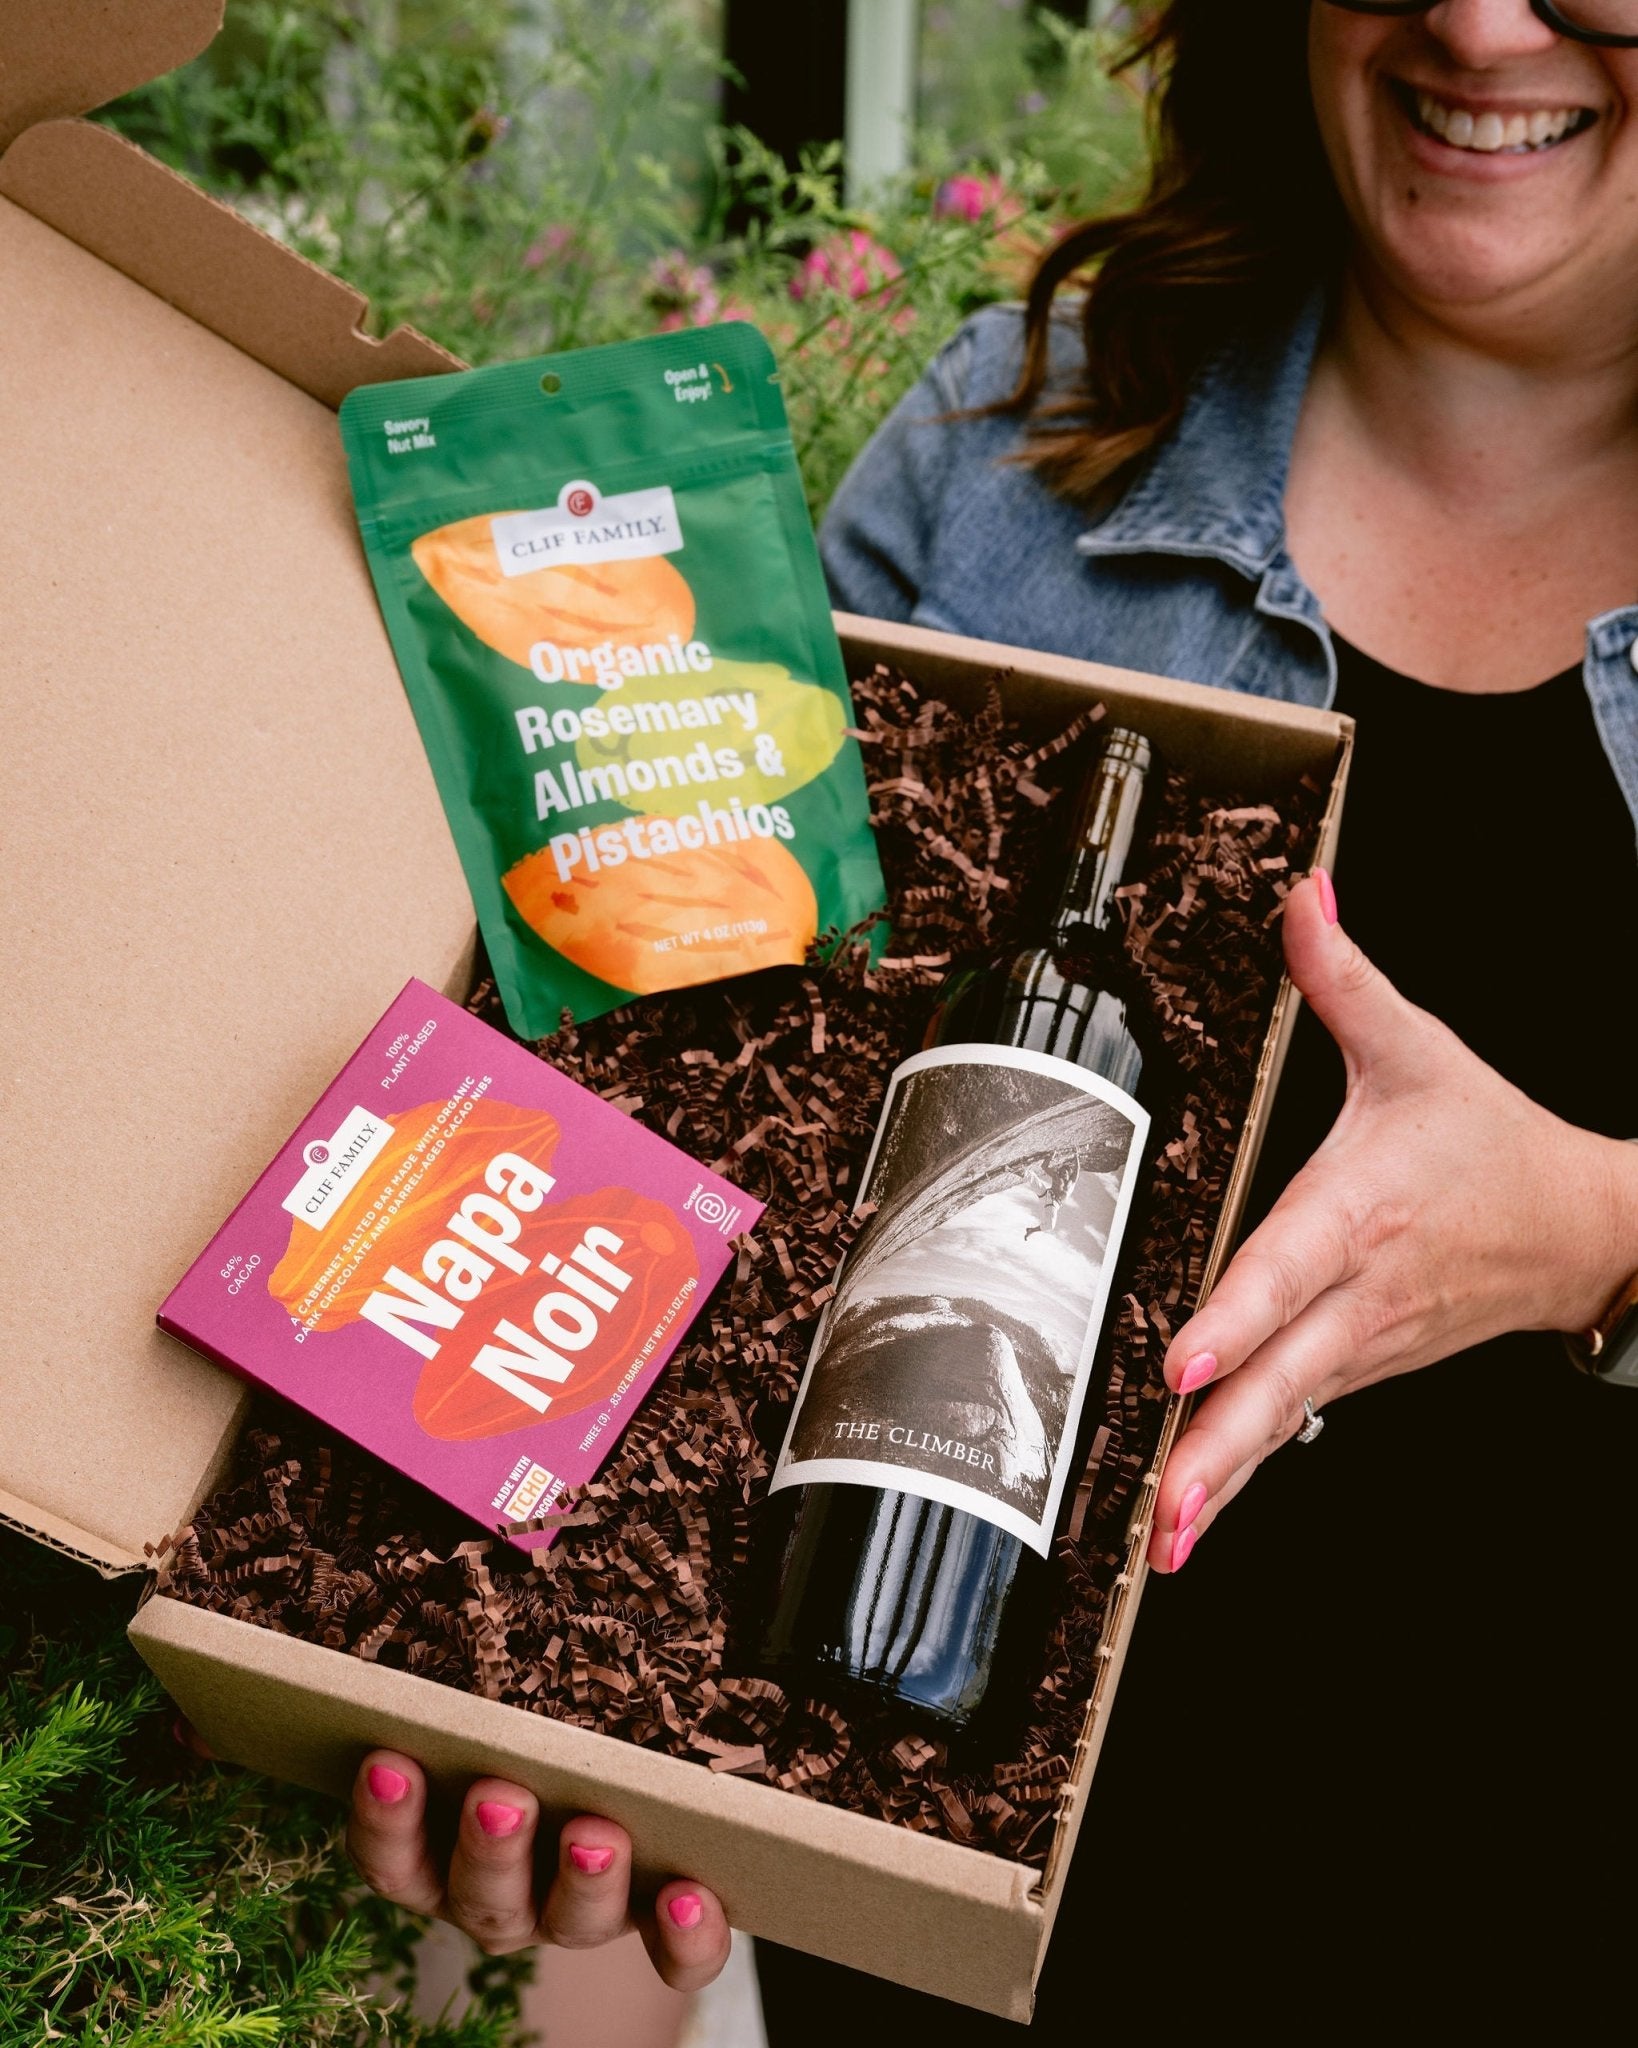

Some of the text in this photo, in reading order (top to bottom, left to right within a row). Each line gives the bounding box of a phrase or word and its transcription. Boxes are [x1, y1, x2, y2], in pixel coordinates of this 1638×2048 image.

[664, 368, 697, 385] Open
[674, 381, 712, 402] Enjoy!
[384, 417, 429, 436] Savory
[387, 434, 436, 454] Nut Mix
[512, 532, 565, 557] CLIF
[529, 634, 713, 691] Organic
[515, 691, 759, 754] Rosemary
[533, 733, 787, 821] Almonds &
[549, 797, 795, 883] Pistachios
[653, 936, 678, 953] NET
[680, 930, 700, 946] WT
[703, 928, 712, 941] 4
[714, 924, 730, 940] OZ
[381, 1019, 437, 1090] PLANT BASED
[385, 1033, 410, 1058] 100%
[290, 1076, 475, 1327] A CABERNET SALTED BAR MADE WITH ORGANIC
[294, 1076, 492, 1344] DARK CHOCOLATE AND BARREL-AGED CACAO NIBS
[305, 1178, 334, 1214] CLIF
[220, 1256, 242, 1278] 64%
[228, 1254, 261, 1294] CACAO
[358, 1152, 556, 1361] Napa
[470, 1226, 633, 1414] Noir
[578, 1423, 602, 1453] THREE
[596, 1412, 611, 1427] (3)
[609, 1394, 622, 1409] .83
[619, 1380, 630, 1394] OZ
[625, 1358, 645, 1383] BARS
[642, 1337, 658, 1356] NET
[652, 1323, 668, 1339] WT.
[663, 1310, 676, 1324] 2.5
[673, 1297, 684, 1311] OZ
[680, 1276, 698, 1300] (70g)
[835, 1422, 995, 1474] THE CLIMBER
[491, 1455, 532, 1510] MADE WITH
[508, 1470, 548, 1516] TCHO
[531, 1478, 566, 1519] OCOLATE
